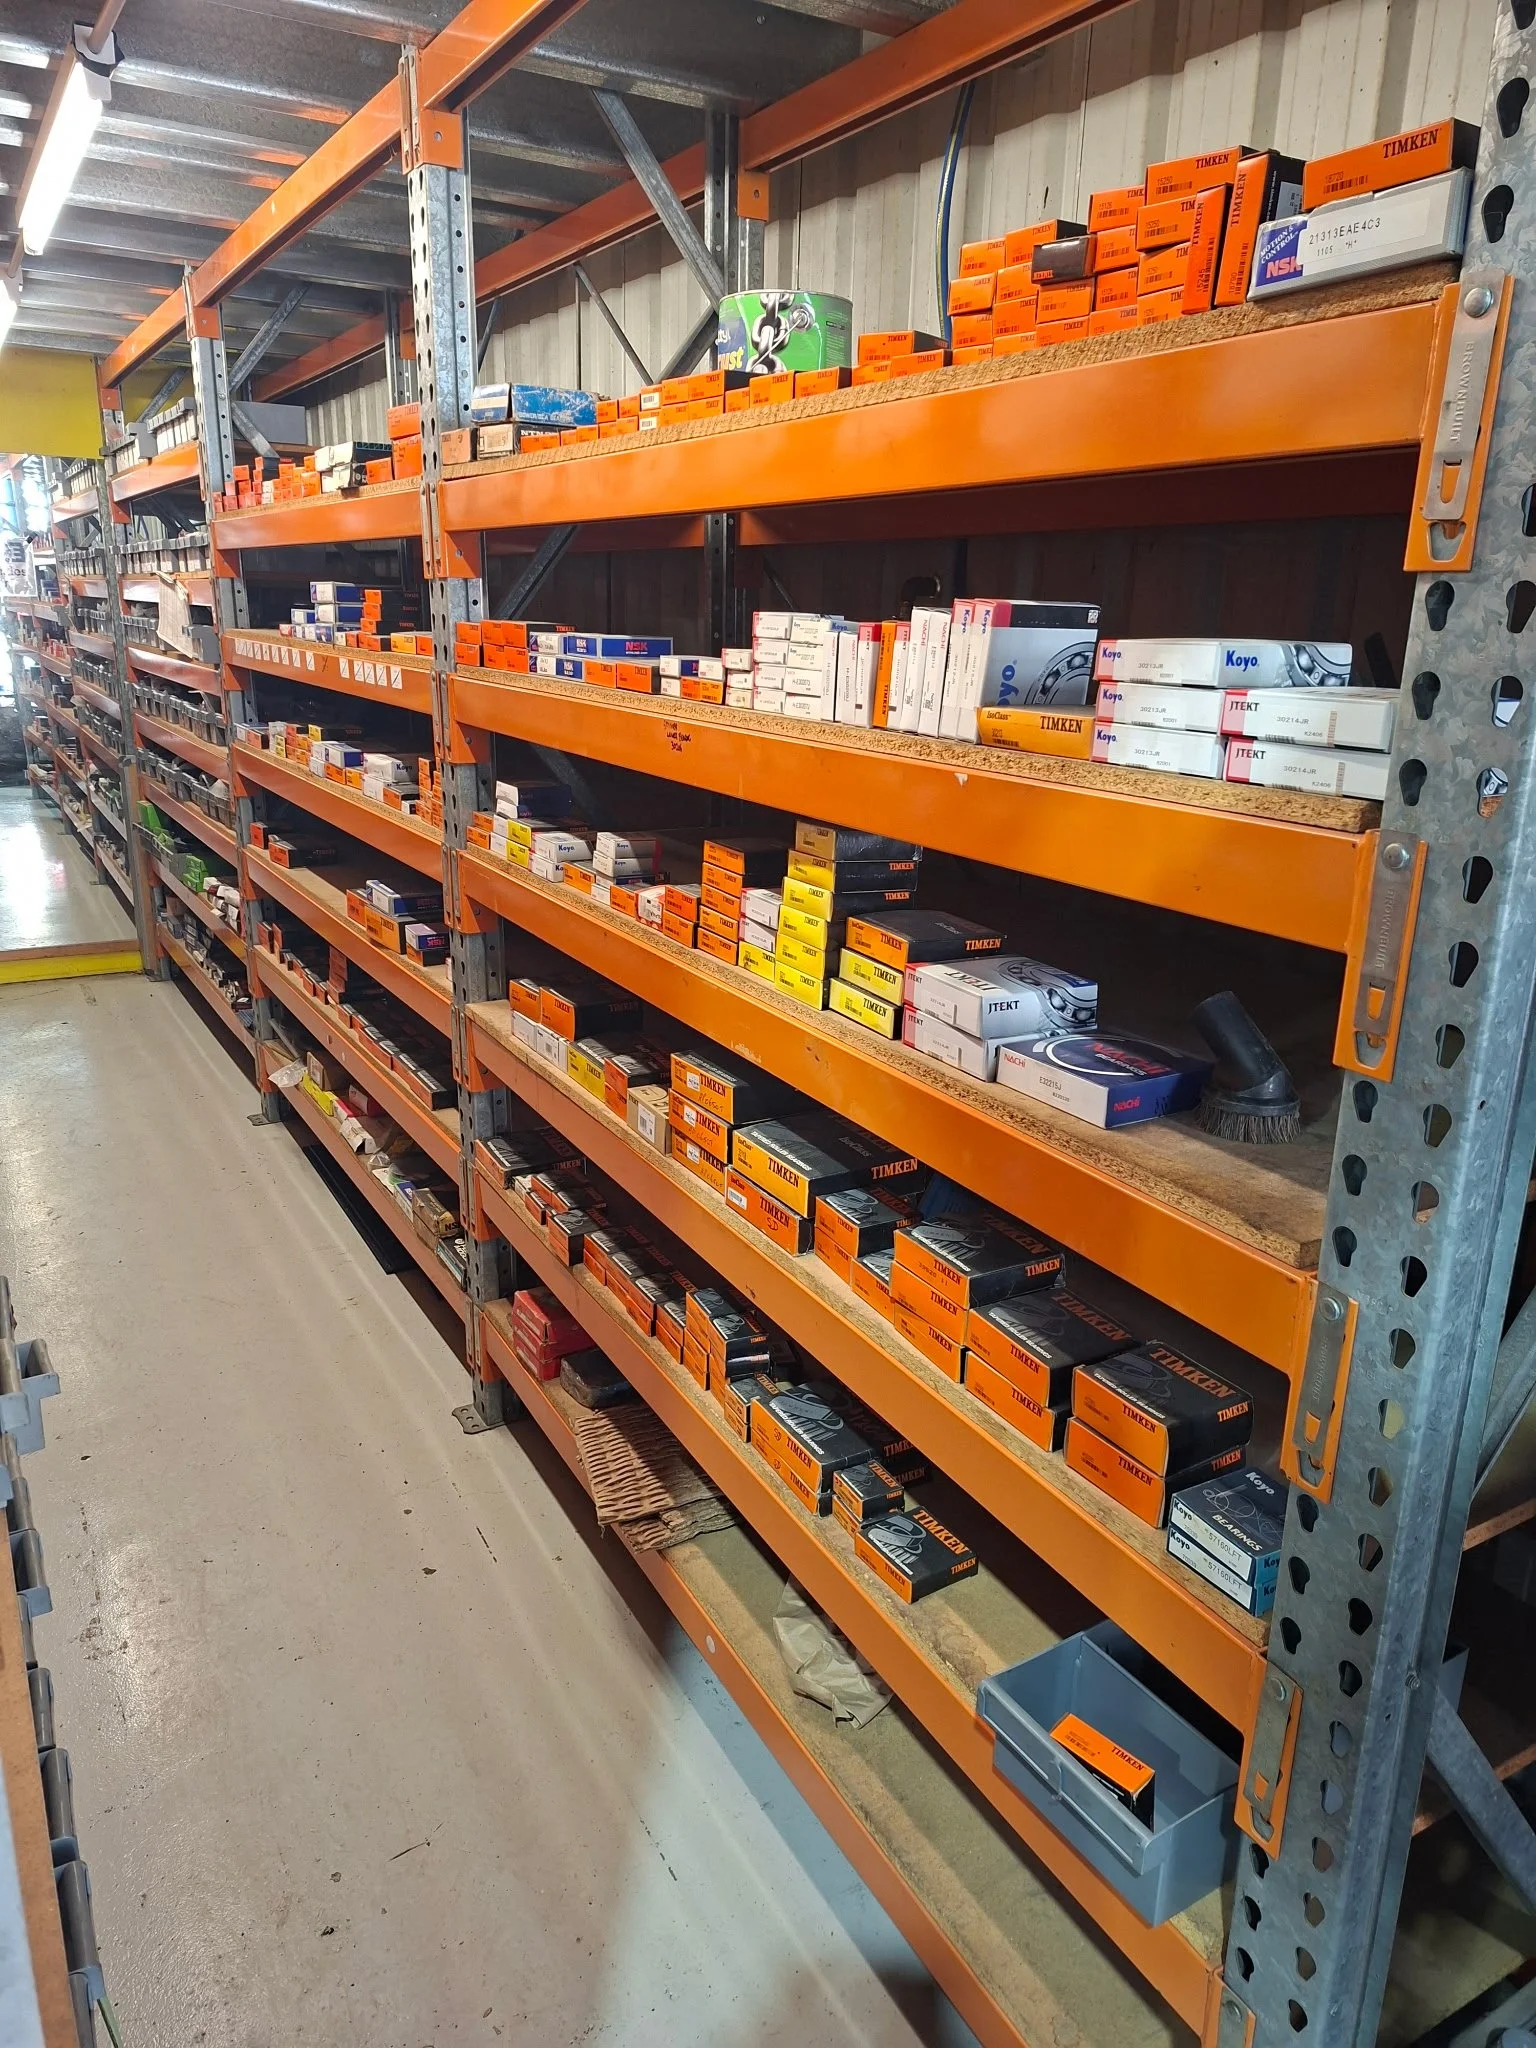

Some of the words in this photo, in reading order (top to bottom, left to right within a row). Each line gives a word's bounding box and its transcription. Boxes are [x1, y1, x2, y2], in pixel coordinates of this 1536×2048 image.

[1383, 129, 1439, 159] TIMKEN
[1196, 153, 1230, 169] TIMKEN
[1127, 188, 1144, 199] TIMK
[1230, 173, 1247, 227] TIMKEN
[1180, 200, 1197, 212] TIM
[1192, 202, 1204, 246] TIMKEN
[1309, 218, 1381, 245] 21313EAE4C3
[1176, 247, 1189, 258] TIM
[1260, 229, 1288, 257] MOTION
[1266, 256, 1302, 279] NSK
[1171, 291, 1184, 302] TIM
[626, 642, 648, 651] NSK
[1102, 647, 1121, 662] Koyo
[1225, 650, 1259, 672] Koyo
[1103, 689, 1123, 703] Koyo
[1229, 701, 1260, 712] JTEKT
[1140, 706, 1167, 714] 30213JR
[1276, 716, 1309, 725] 30214JR
[1040, 716, 1083, 733] TIMKEN
[1097, 729, 1117, 744] Koyo
[1134, 748, 1160, 757] 30213JR
[1236, 748, 1266, 760] JTEKT
[1284, 765, 1317, 774] 30214JR
[884, 892, 910, 900] TIMKEN
[880, 933, 902, 951] TIMKEN
[966, 939, 1001, 950] TIMKEN
[873, 966, 897, 985] TIMKEN
[863, 998, 887, 1017] TIMKEN
[988, 1000, 1020, 1014] JTEKT
[1085, 1042, 1172, 1076] NACHI
[700, 1073, 726, 1097] TIMKEN
[1039, 1076, 1062, 1091] E32215J
[695, 1110, 720, 1136] TIMKEN
[700, 1149, 725, 1173] TIMKEN
[871, 1158, 917, 1179] TIMKEN
[768, 1157, 800, 1188] TIMKEN
[760, 1196, 790, 1228] TIMKEN
[934, 1259, 961, 1285] TIMKEN
[1025, 1258, 1061, 1277] TIMKEN
[931, 1291, 958, 1316] TIMKEN
[1052, 1293, 1132, 1341] TIMKEN
[928, 1326, 953, 1352] TIMKEN
[1010, 1343, 1040, 1374] TIMKEN
[1150, 1348, 1237, 1398] TIMKEN
[1011, 1388, 1042, 1417] TIMKEN
[1217, 1402, 1249, 1422] TIMKEN
[1122, 1404, 1157, 1433] TIMKEN
[786, 1437, 813, 1469] TIMKEN
[1212, 1449, 1241, 1471] TIMKEN
[1118, 1456, 1153, 1486] TIMKEN
[789, 1471, 810, 1498] TIMKEN
[1246, 1472, 1276, 1495] Koyo
[1174, 1501, 1193, 1521] Koyo
[912, 1509, 971, 1555] TIMKEN
[1170, 1530, 1191, 1551] Koyo
[1212, 1514, 1263, 1551] BEARINGS
[951, 1557, 976, 1575] TIMKEN
[1264, 1557, 1280, 1568] Koy
[1111, 1746, 1145, 1771] TIMKEN
